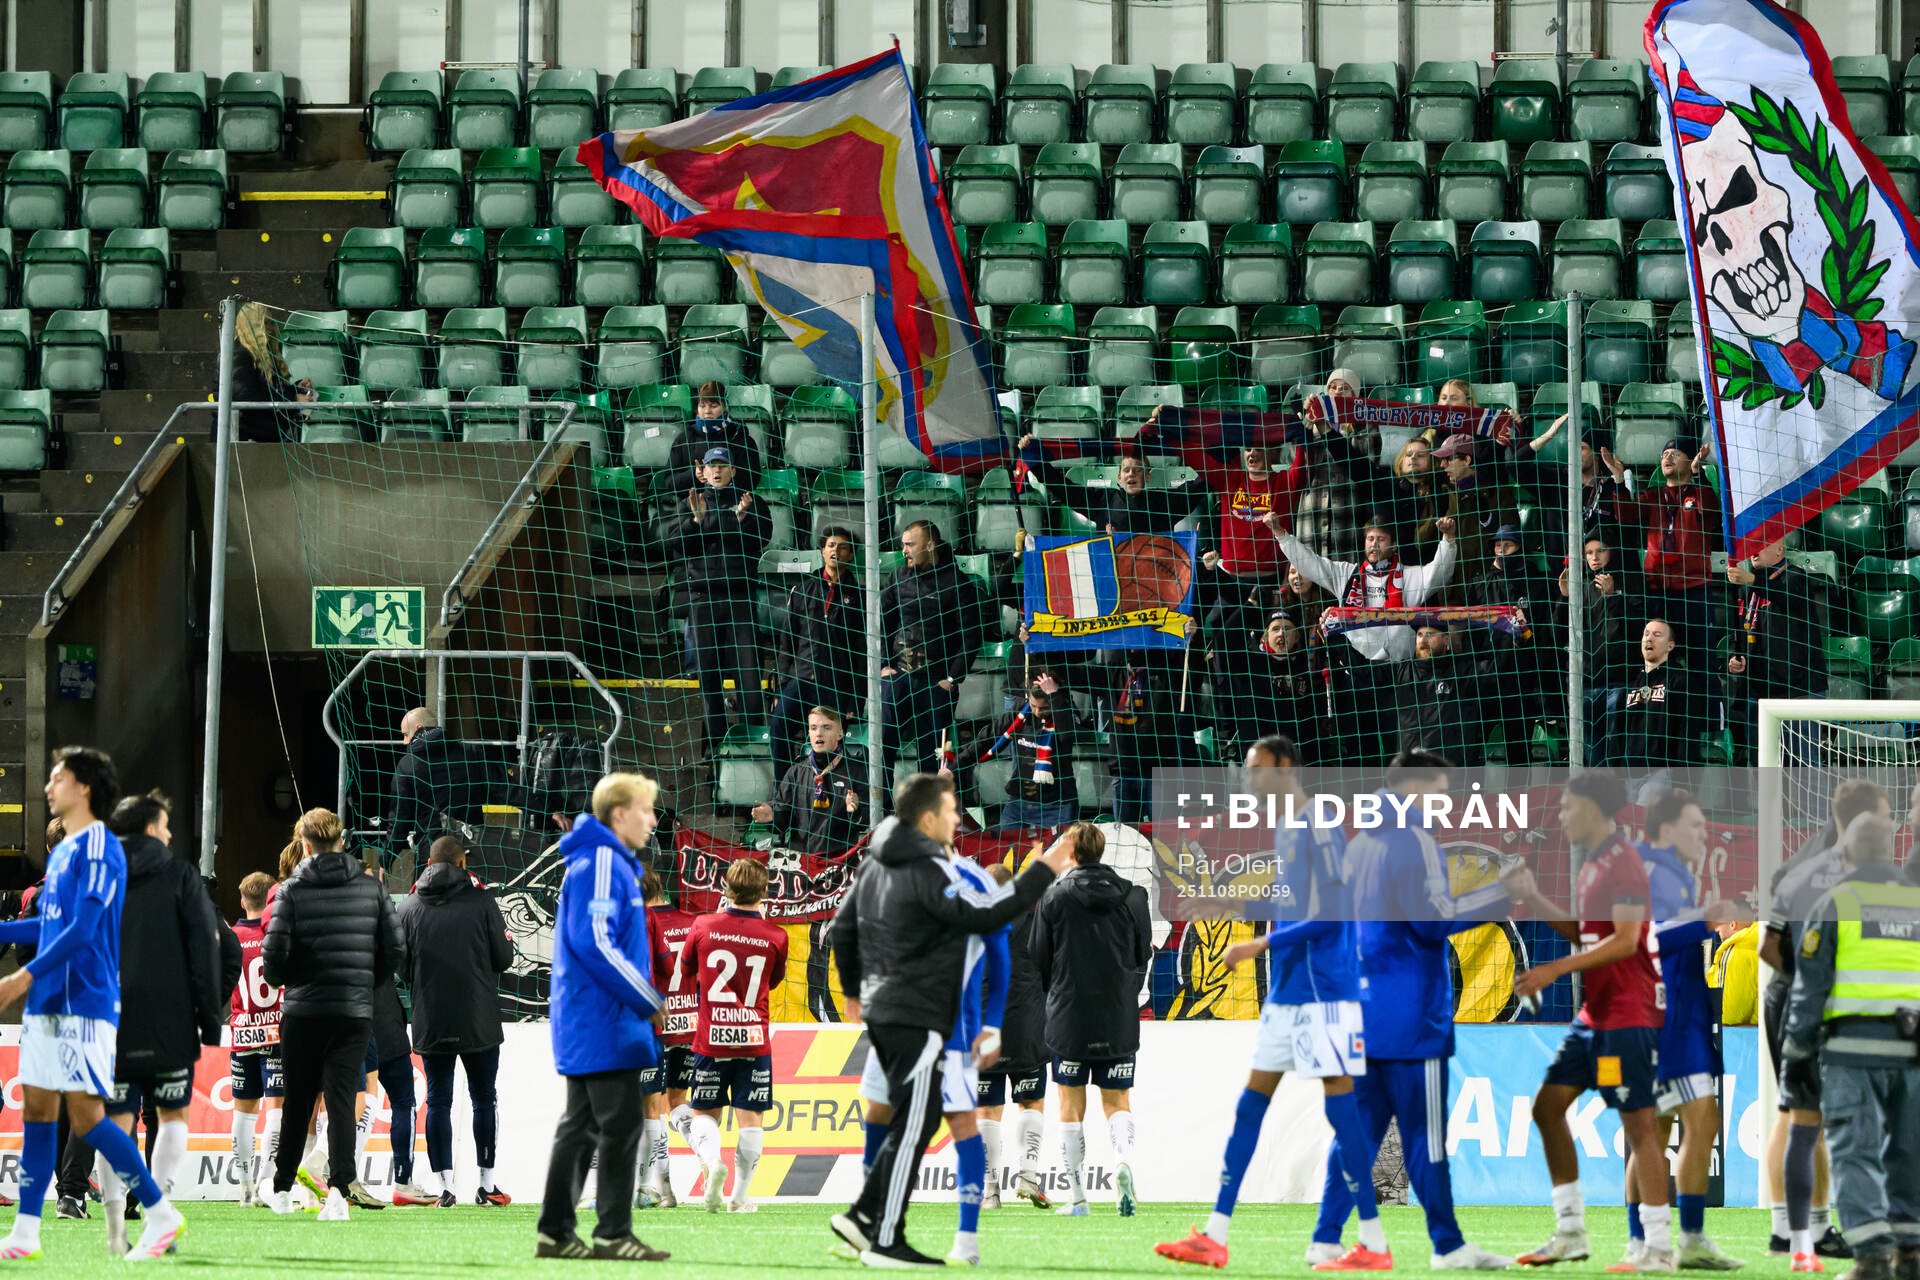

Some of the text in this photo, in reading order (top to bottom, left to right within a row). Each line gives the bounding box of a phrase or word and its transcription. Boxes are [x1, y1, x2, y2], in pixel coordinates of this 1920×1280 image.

[1353, 399, 1467, 428] ÖRGRYTE IS
[706, 949, 767, 1008] 21
[711, 1028, 748, 1044] BESAB
[1108, 1063, 1135, 1080] NTEX
[266, 1073, 284, 1089] NTE
[1013, 1078, 1039, 1095] NTEX
[693, 1086, 720, 1100] NTEX
[748, 1087, 769, 1102] NTE
[1002, 1166, 1113, 1193] logisik
